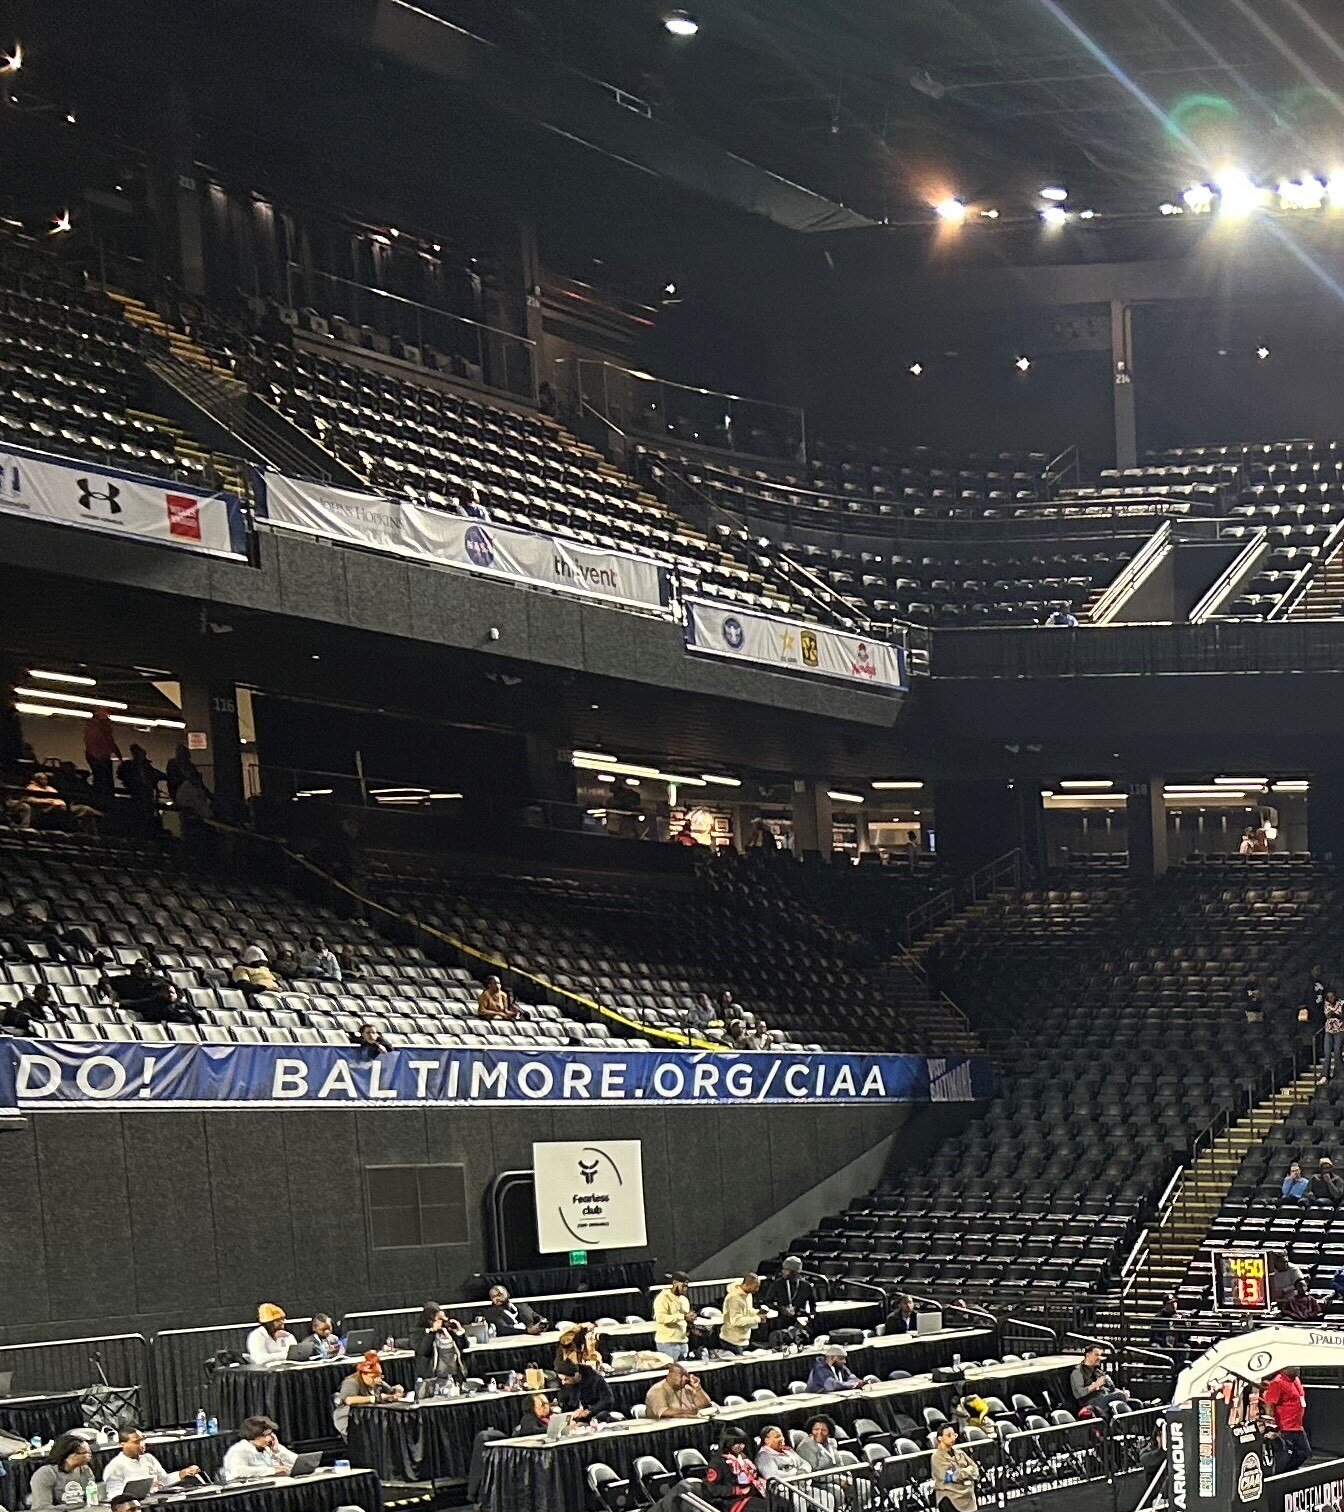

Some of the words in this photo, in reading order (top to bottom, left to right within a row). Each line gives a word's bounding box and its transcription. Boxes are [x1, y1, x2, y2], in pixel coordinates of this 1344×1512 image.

[16, 1055, 154, 1099] DO!
[272, 1056, 888, 1101] BALTIMORE.ORG/CIAA
[1230, 1257, 1264, 1278] 4:50
[1236, 1278, 1260, 1303] 13
[1170, 1421, 1187, 1506] ARMOUR
